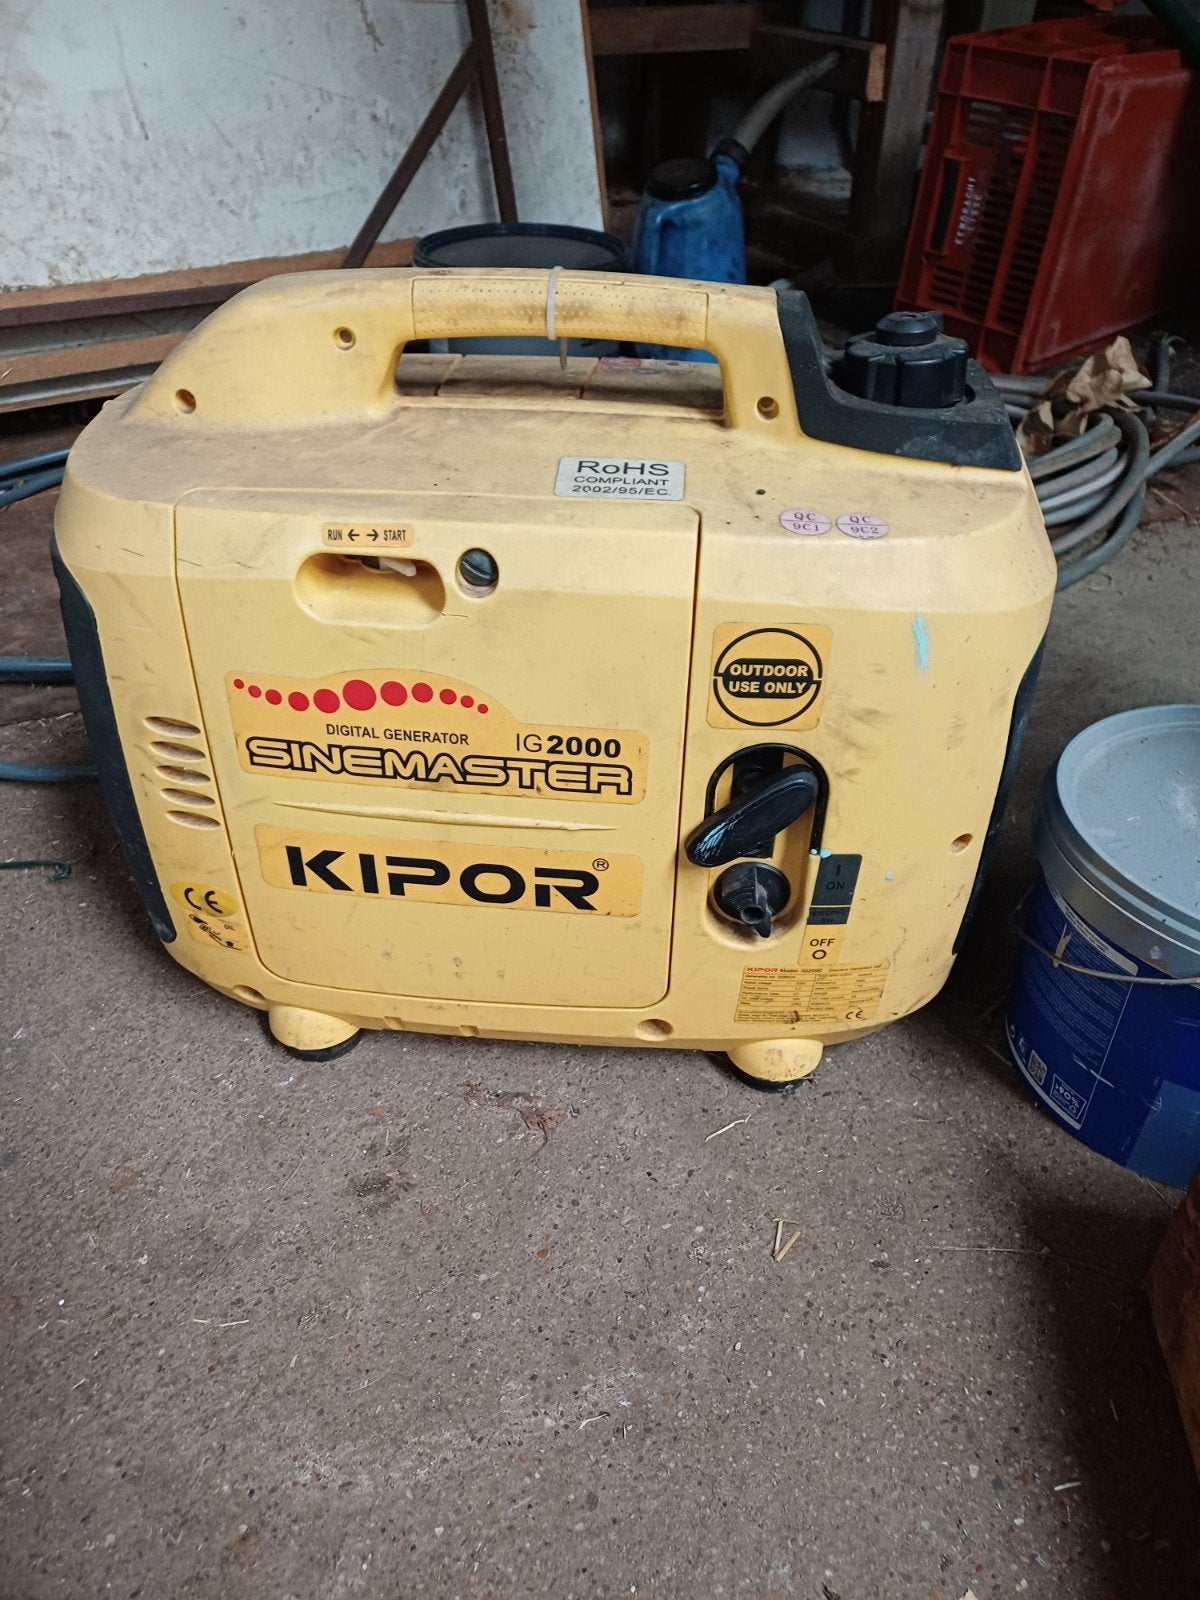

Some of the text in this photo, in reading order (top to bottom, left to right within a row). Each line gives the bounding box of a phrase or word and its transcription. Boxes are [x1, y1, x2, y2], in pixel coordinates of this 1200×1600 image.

[576, 460, 670, 477] RoHS
[573, 475, 670, 487] COMPLIANT
[793, 511, 817, 522] QC
[848, 514, 872, 525] QC
[792, 522, 820, 533] 9C1
[850, 525, 880, 535] 9C2
[327, 529, 407, 542] RUN START
[729, 663, 810, 678] OUTDOOR
[728, 680, 808, 695] USE ONLY
[325, 723, 470, 746] DIGITAL GENERATOR
[245, 735, 634, 797] SINEMASTER
[825, 880, 845, 892] ON
[809, 937, 836, 948] OFF
